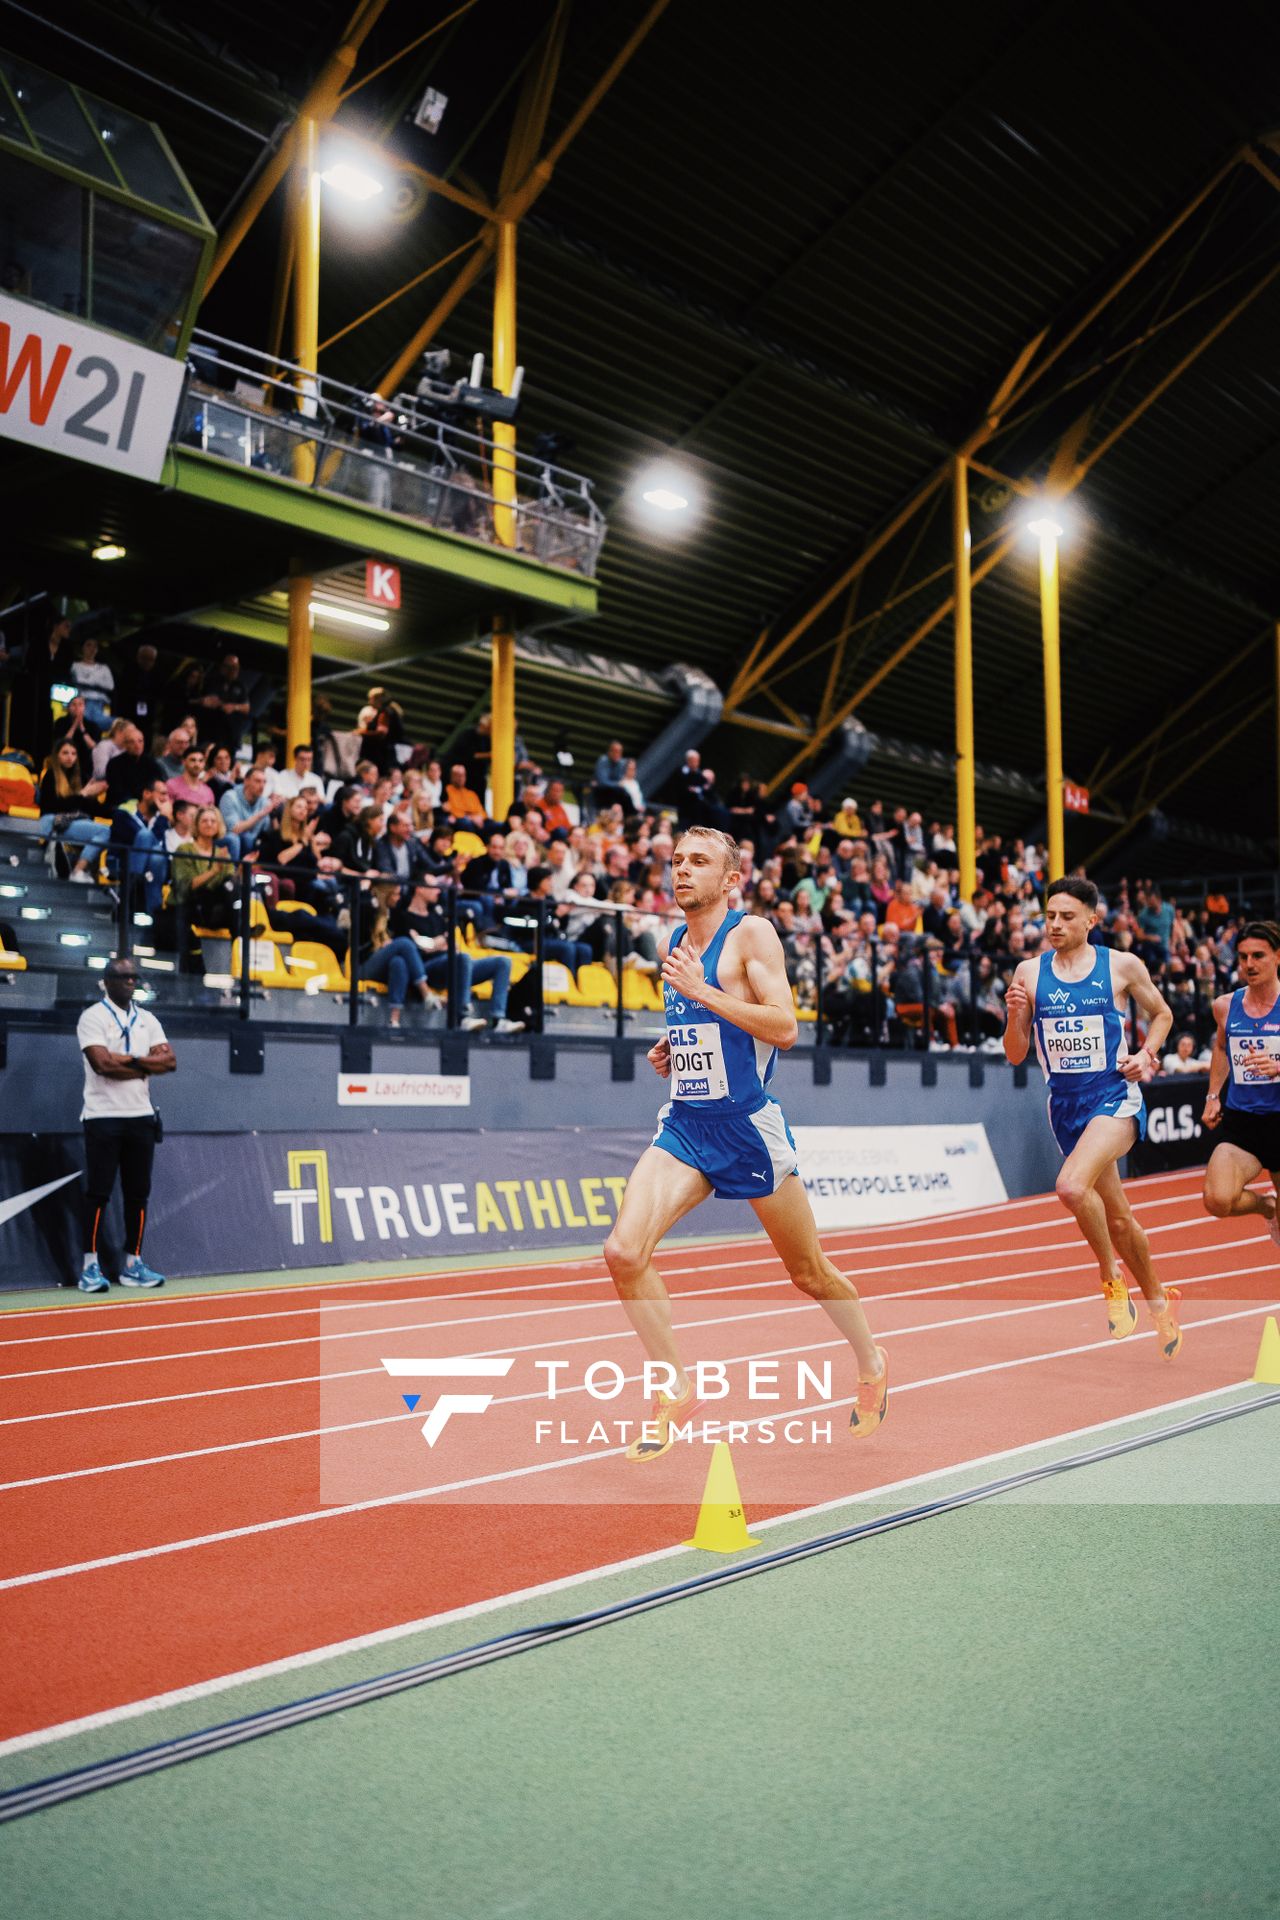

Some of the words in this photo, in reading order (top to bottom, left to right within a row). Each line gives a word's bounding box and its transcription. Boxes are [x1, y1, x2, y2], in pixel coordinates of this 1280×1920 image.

[372, 565, 395, 601] K
[1047, 1037, 1100, 1052] PROBST
[1069, 1058, 1089, 1066] PLAN
[375, 1080, 464, 1098] Laufrichtung
[685, 1081, 708, 1091] PLAN
[1147, 1104, 1202, 1144] GLS.
[803, 1174, 906, 1197] METROPOLE
[908, 1172, 952, 1192] RUHR
